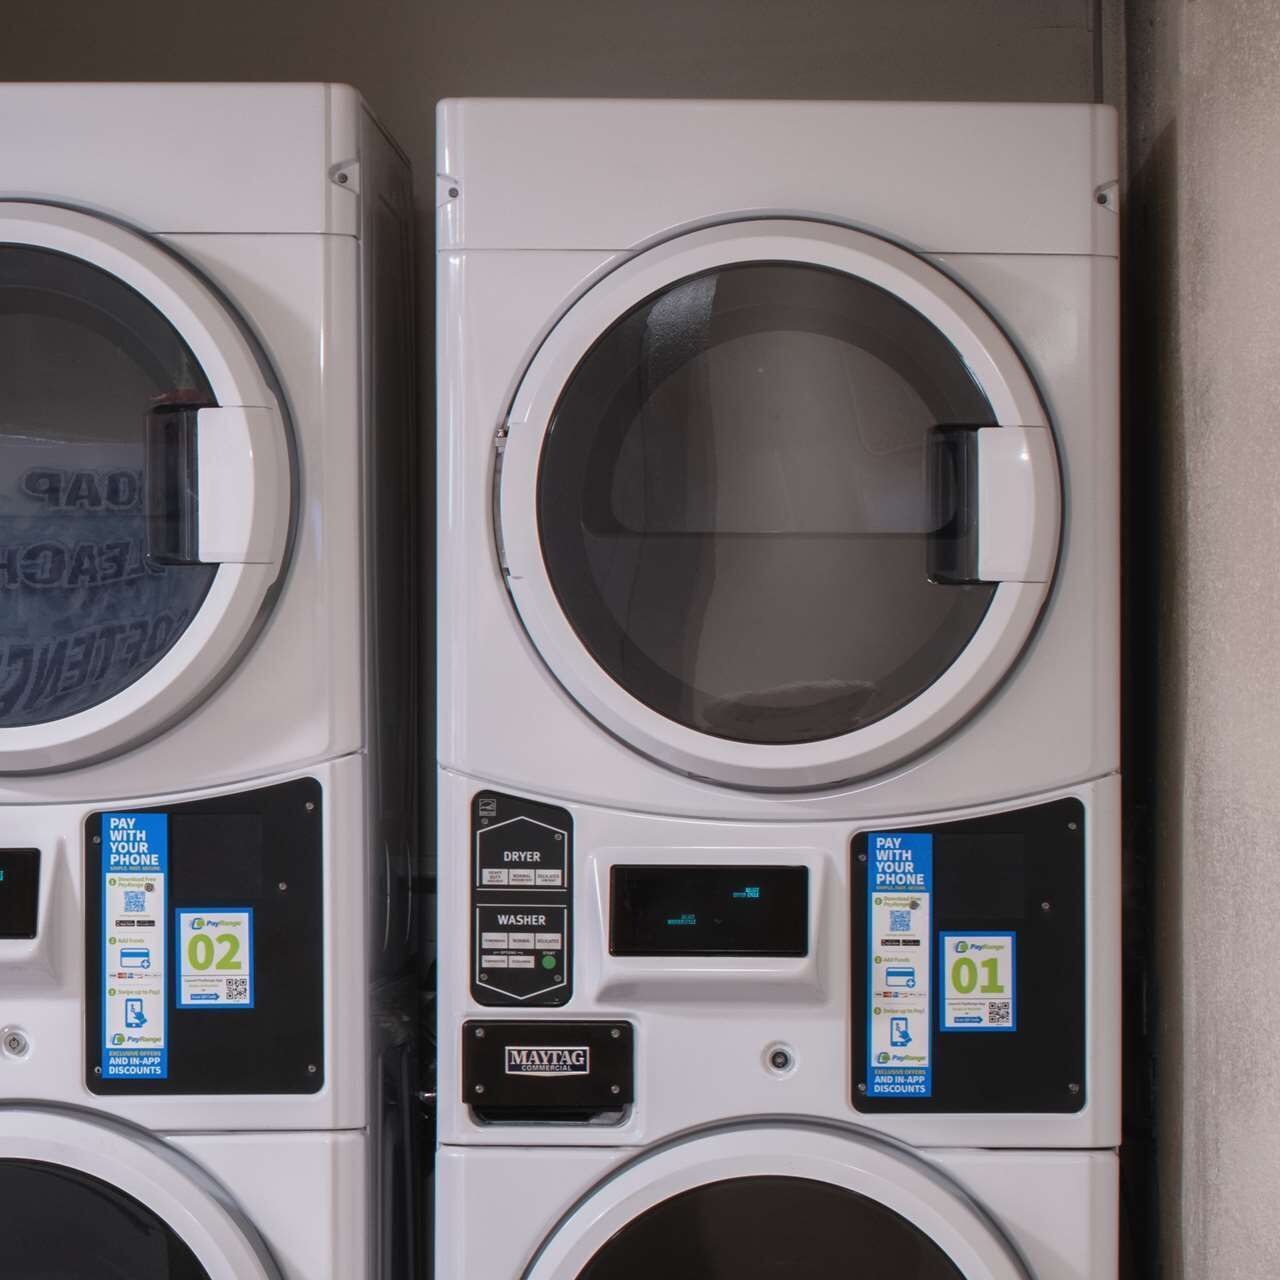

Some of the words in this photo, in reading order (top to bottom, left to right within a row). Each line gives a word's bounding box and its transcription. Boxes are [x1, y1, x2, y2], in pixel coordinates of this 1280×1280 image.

[110, 817, 136, 829] PAY
[110, 830, 146, 841] WITH
[110, 842, 149, 853] YOUR
[876, 837, 901, 849] PAY
[110, 854, 159, 865] PHONE
[503, 851, 541, 862] DRYER
[876, 850, 912, 861] WITH
[876, 862, 914, 873] YOUR
[876, 874, 925, 885] PHONE
[207, 920, 241, 928] PayRange
[497, 915, 546, 925] WASHER
[188, 933, 242, 971] 02
[951, 957, 1005, 994] 01
[109, 1057, 128, 1065] AND
[130, 1057, 161, 1065] IN-APP
[510, 1051, 585, 1065] MAYTAG
[109, 1066, 161, 1074] DISCOUNTS
[874, 1075, 893, 1083] AND
[895, 1075, 925, 1083] IN-APP
[874, 1085, 926, 1093] DISCOUNTS
